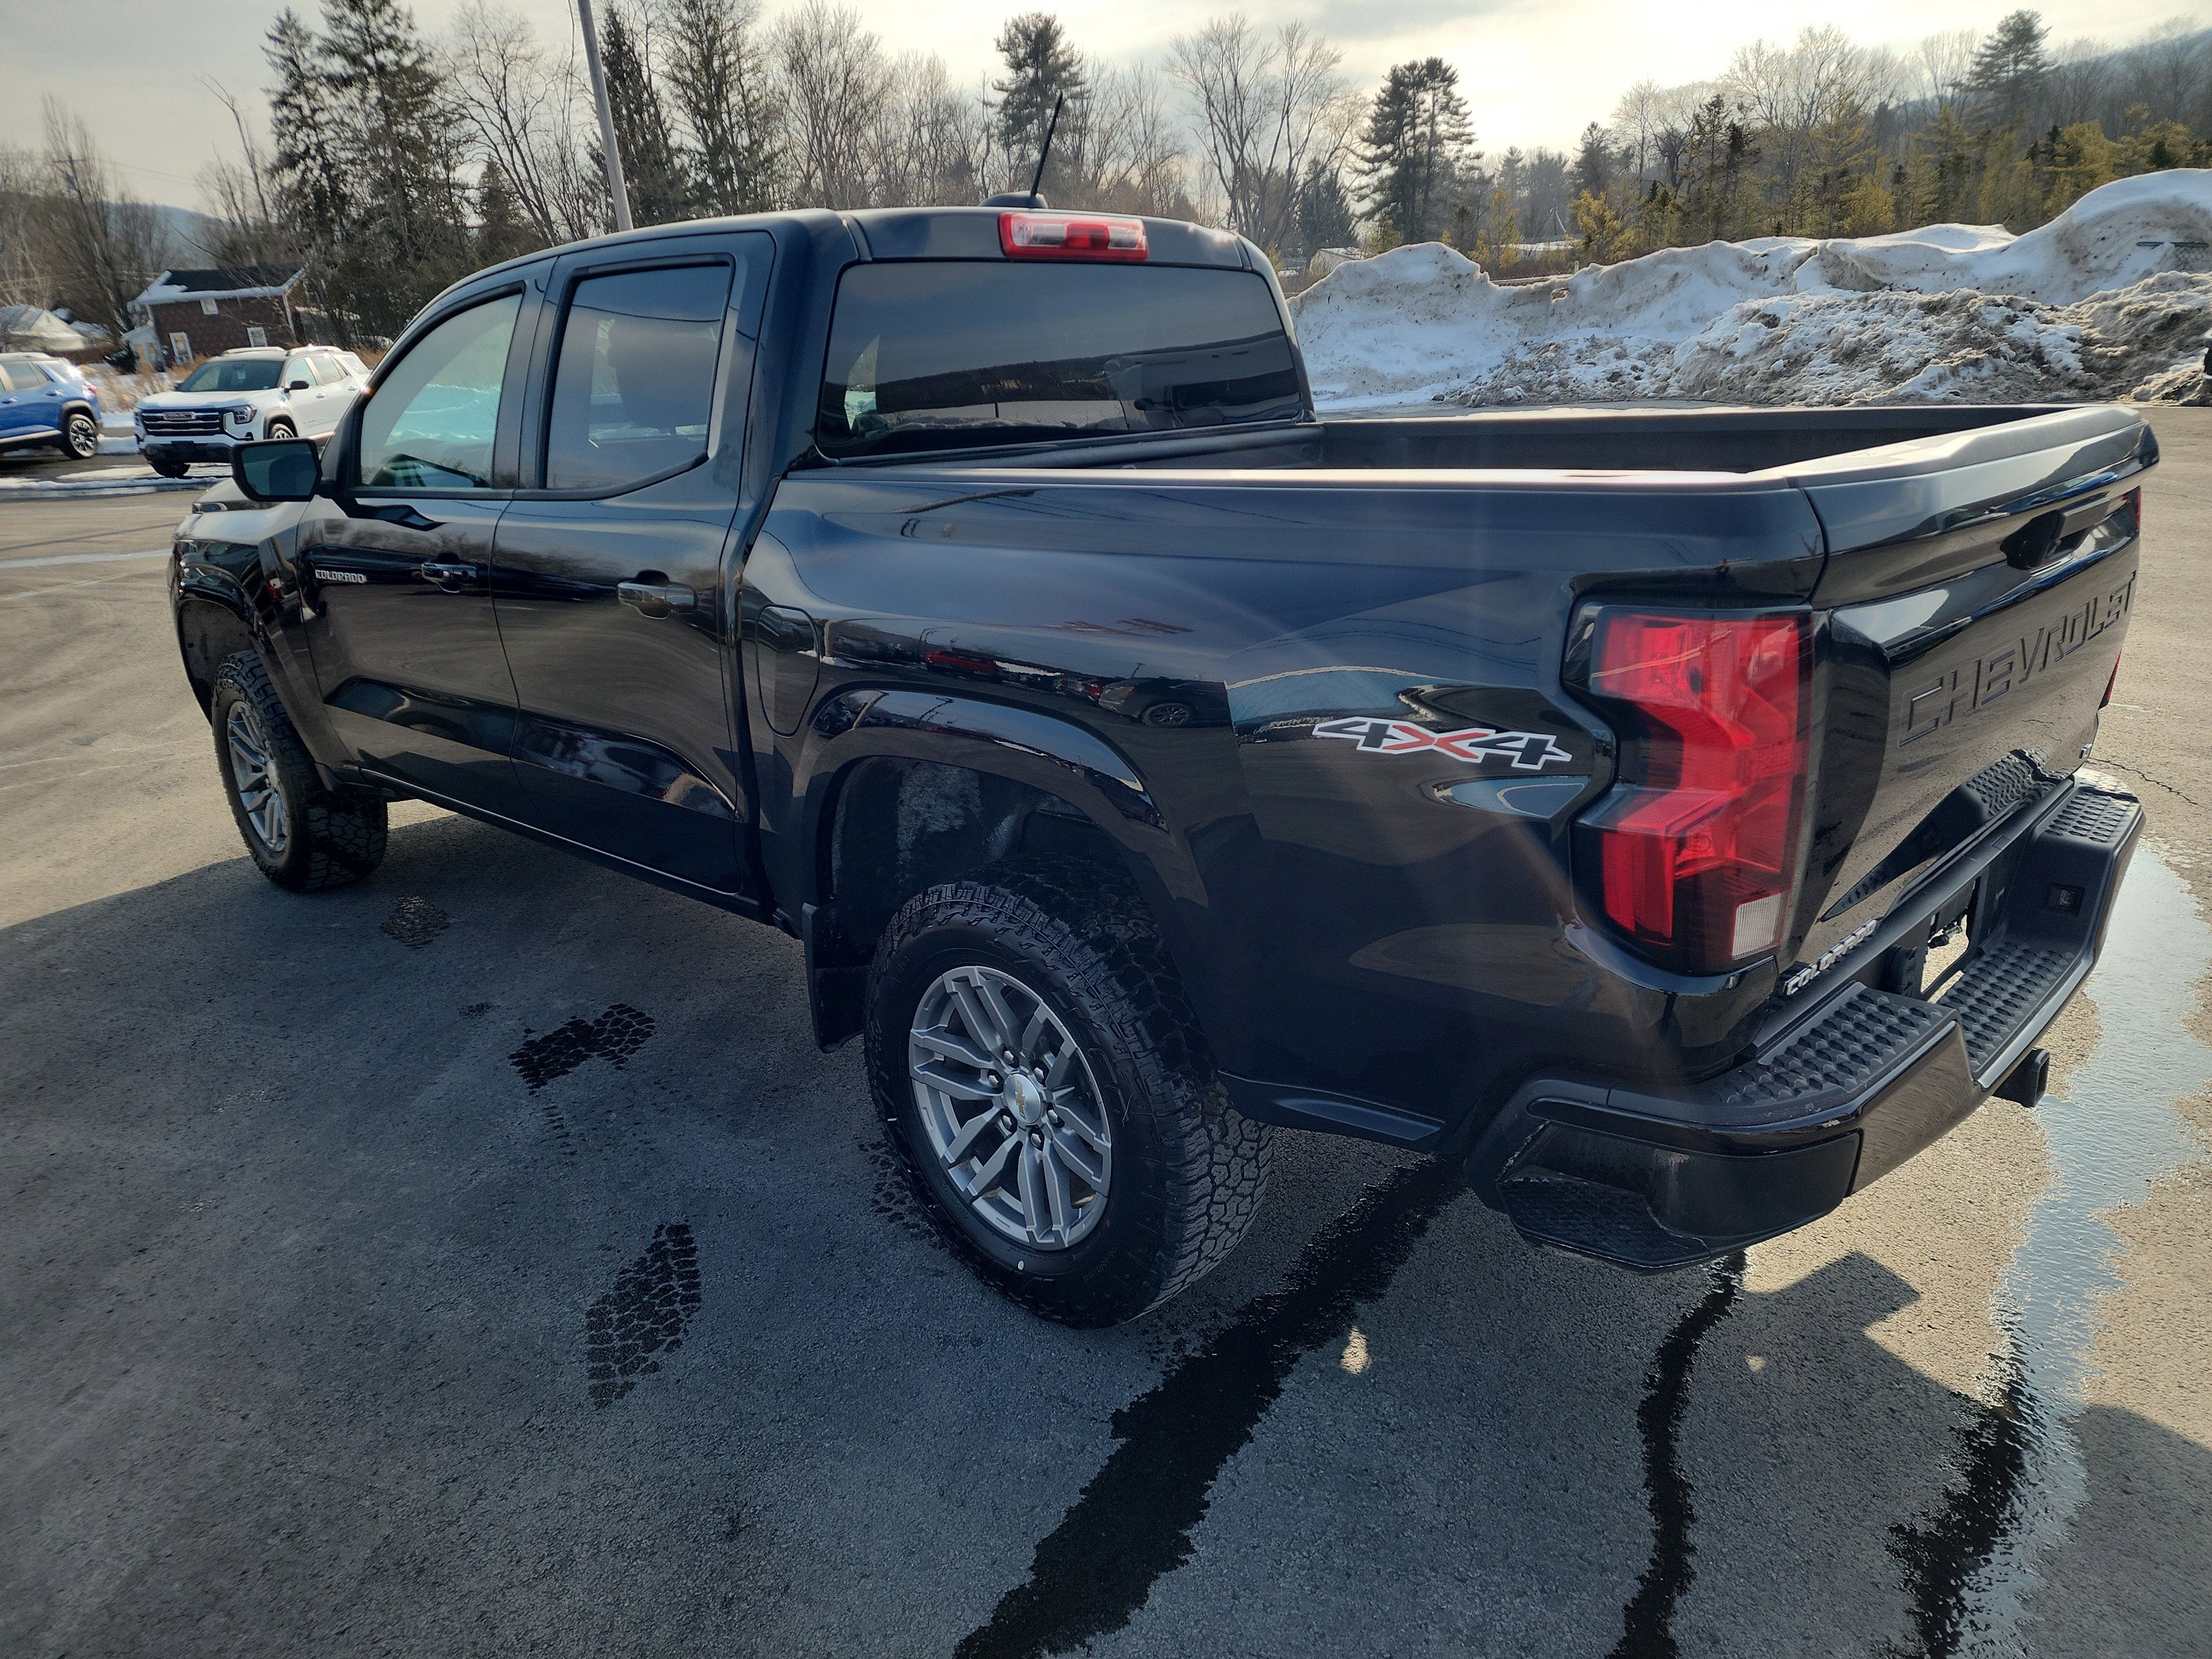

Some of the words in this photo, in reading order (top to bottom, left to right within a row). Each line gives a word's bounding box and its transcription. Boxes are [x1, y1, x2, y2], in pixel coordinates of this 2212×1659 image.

[315, 570, 367, 583] COLORADO
[1899, 570, 2137, 747] CHEVROLET
[1783, 919, 1877, 995] COLORADO
